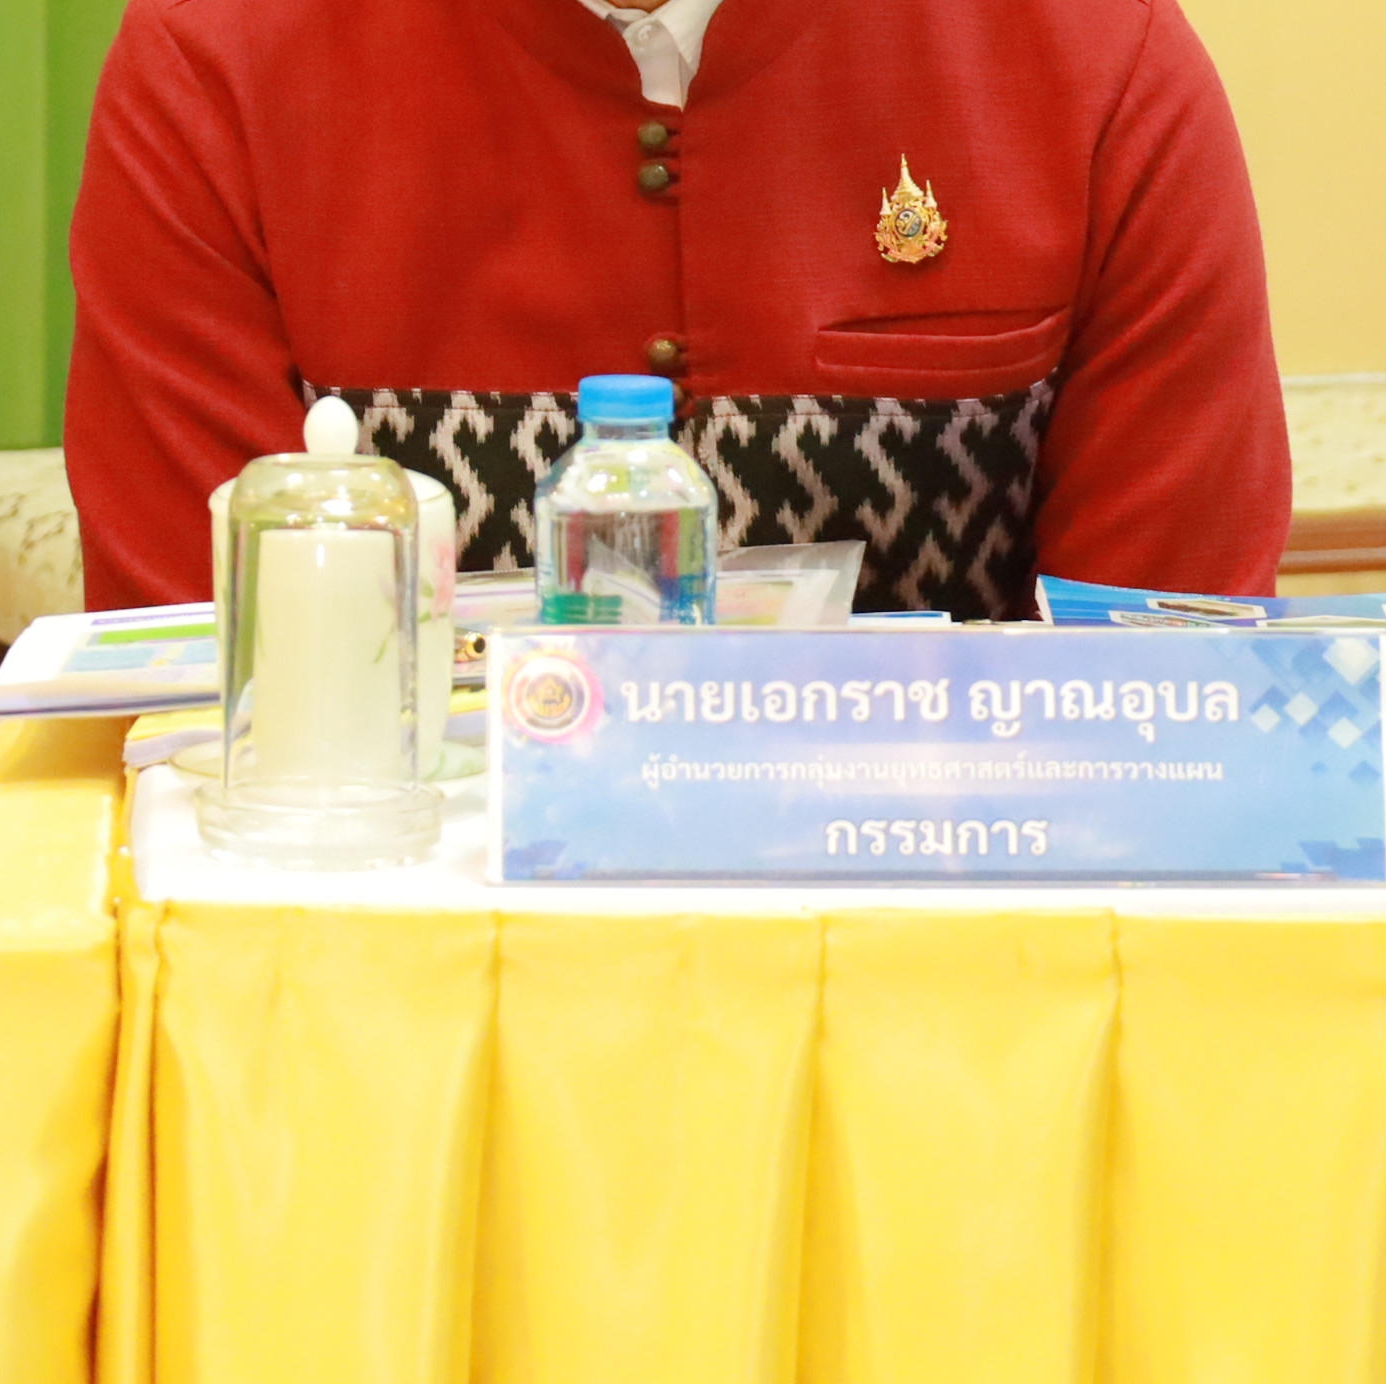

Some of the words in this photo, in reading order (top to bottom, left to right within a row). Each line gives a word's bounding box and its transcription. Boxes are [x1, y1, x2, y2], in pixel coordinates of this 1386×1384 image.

[622, 676, 949, 723] นายเอกราช
[970, 677, 1241, 743] ญาณอุบล
[642, 752, 1223, 788] ผู้อำนวยการกลุ่มงานยุทธศาสตร์และการวางแผน
[826, 816, 1047, 857] กรรมการ
